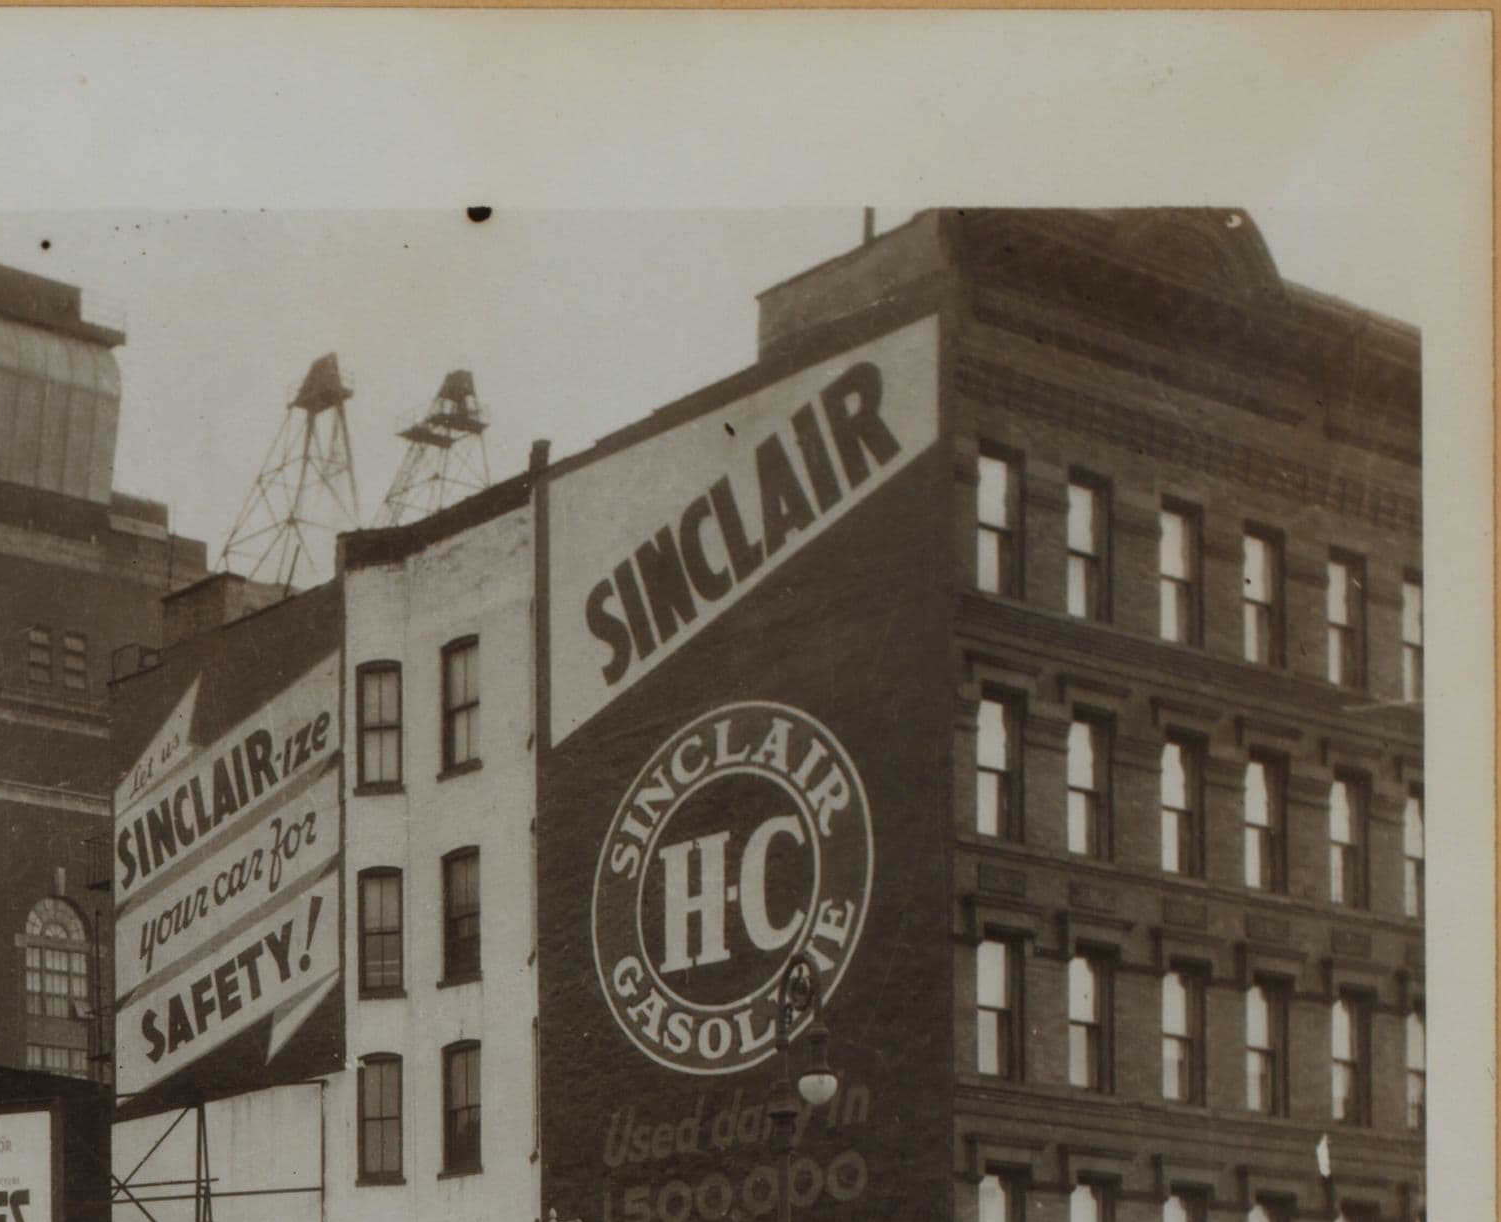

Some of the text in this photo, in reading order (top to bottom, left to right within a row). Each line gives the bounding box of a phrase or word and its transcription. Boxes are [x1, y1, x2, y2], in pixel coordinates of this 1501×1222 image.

[585, 361, 902, 687] SINCLAIR
[610, 717, 852, 880] SINCLAIR
[140, 811, 318, 973] your car for
[141, 896, 323, 1063] SAFETY!
[613, 899, 855, 1060] GASOLE
[603, 1095, 705, 1168] Used
